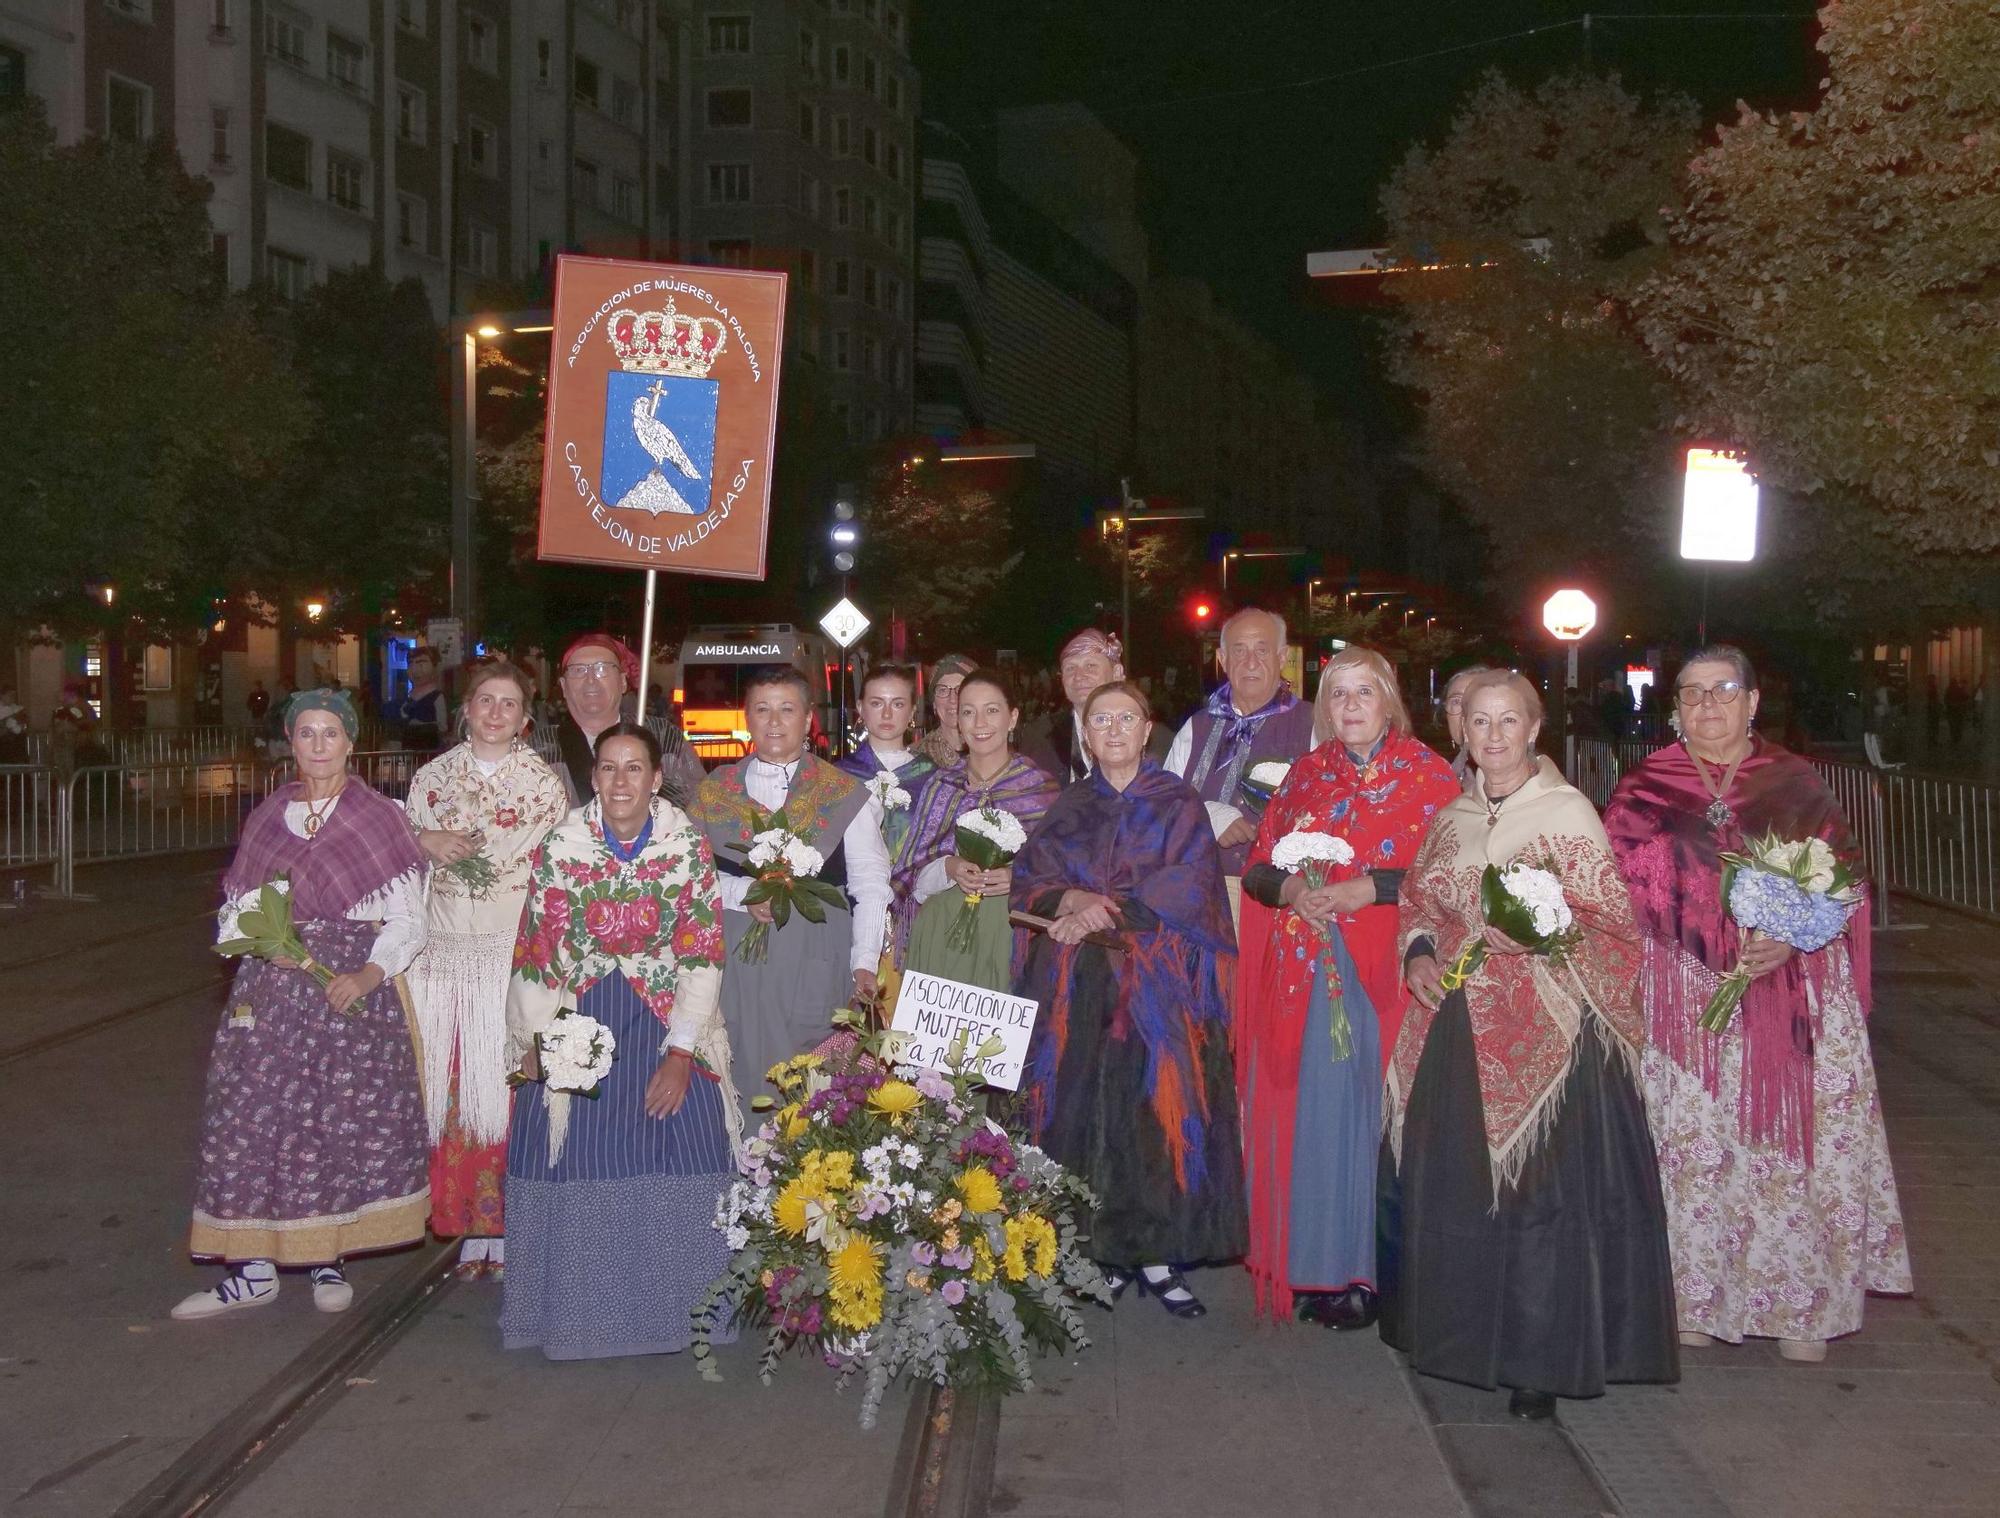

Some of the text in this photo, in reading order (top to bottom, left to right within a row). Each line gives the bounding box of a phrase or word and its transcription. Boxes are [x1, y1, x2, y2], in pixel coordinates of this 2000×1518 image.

[567, 279, 761, 383] ASOCIACION DE MUJERES LA PALOMA
[565, 442, 755, 554] CASTEJON DE VALDEJASA
[835, 614, 856, 631] 30
[695, 644, 781, 656] AMBULANCIA
[904, 976, 1034, 1029] ASOCIACIÓN DE
